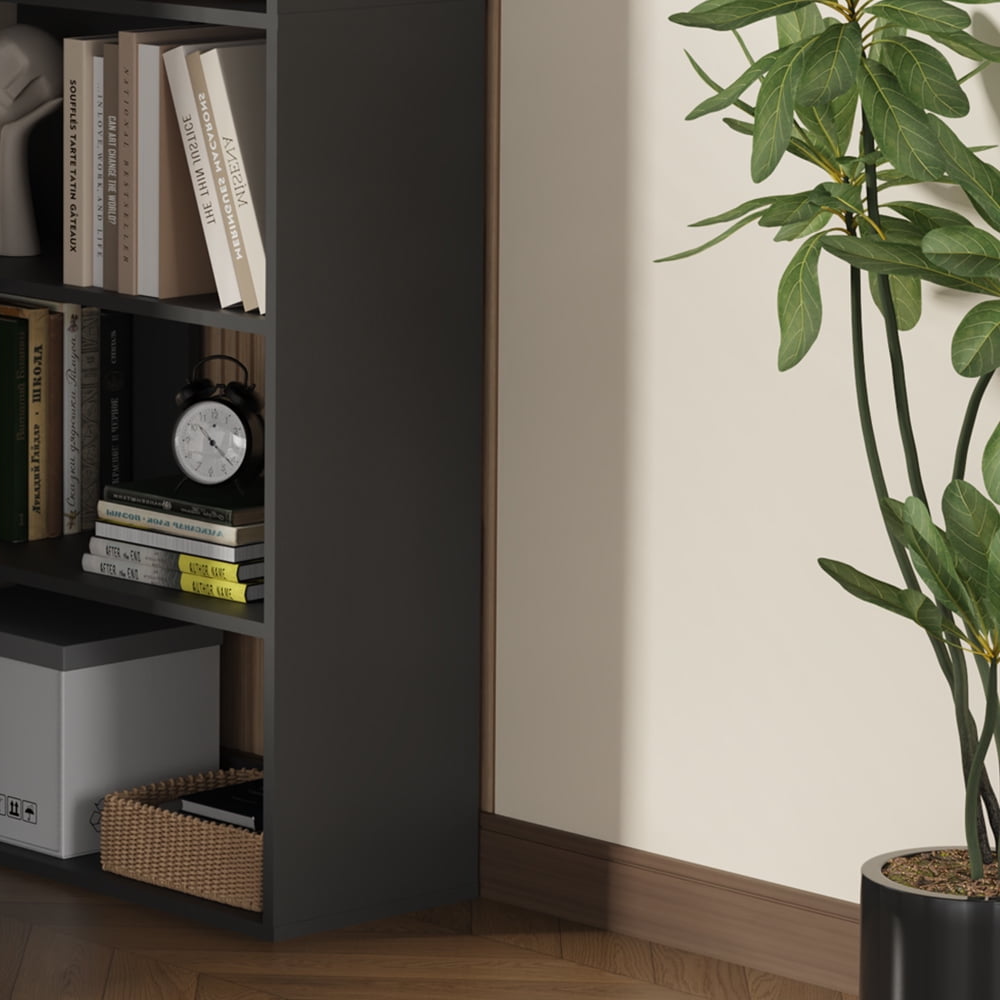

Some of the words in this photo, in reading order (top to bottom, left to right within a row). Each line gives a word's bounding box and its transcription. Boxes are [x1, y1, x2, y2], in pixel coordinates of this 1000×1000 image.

[69, 80, 78, 131] SOUFFLÉS
[108, 115, 117, 131] CAN
[69, 134, 77, 166] TARTE
[108, 131, 117, 147] ART
[108, 148, 117, 177] CHANGE
[69, 168, 77, 201] TATIN
[108, 179, 117, 193] THE
[108, 194, 117, 225] WORLD?
[69, 203, 79, 253] GÂTEAUX
[32, 343, 44, 404] ШКОЛА
[105, 545, 121, 558] AFTER
[130, 549, 141, 562] END
[99, 562, 117, 576] AFTER
[126, 566, 139, 581] END
[188, 561, 210, 576] AUTHOR
[211, 565, 226, 579] NAME
[192, 580, 214, 596] AUTHOR
[216, 584, 232, 600] NAME
